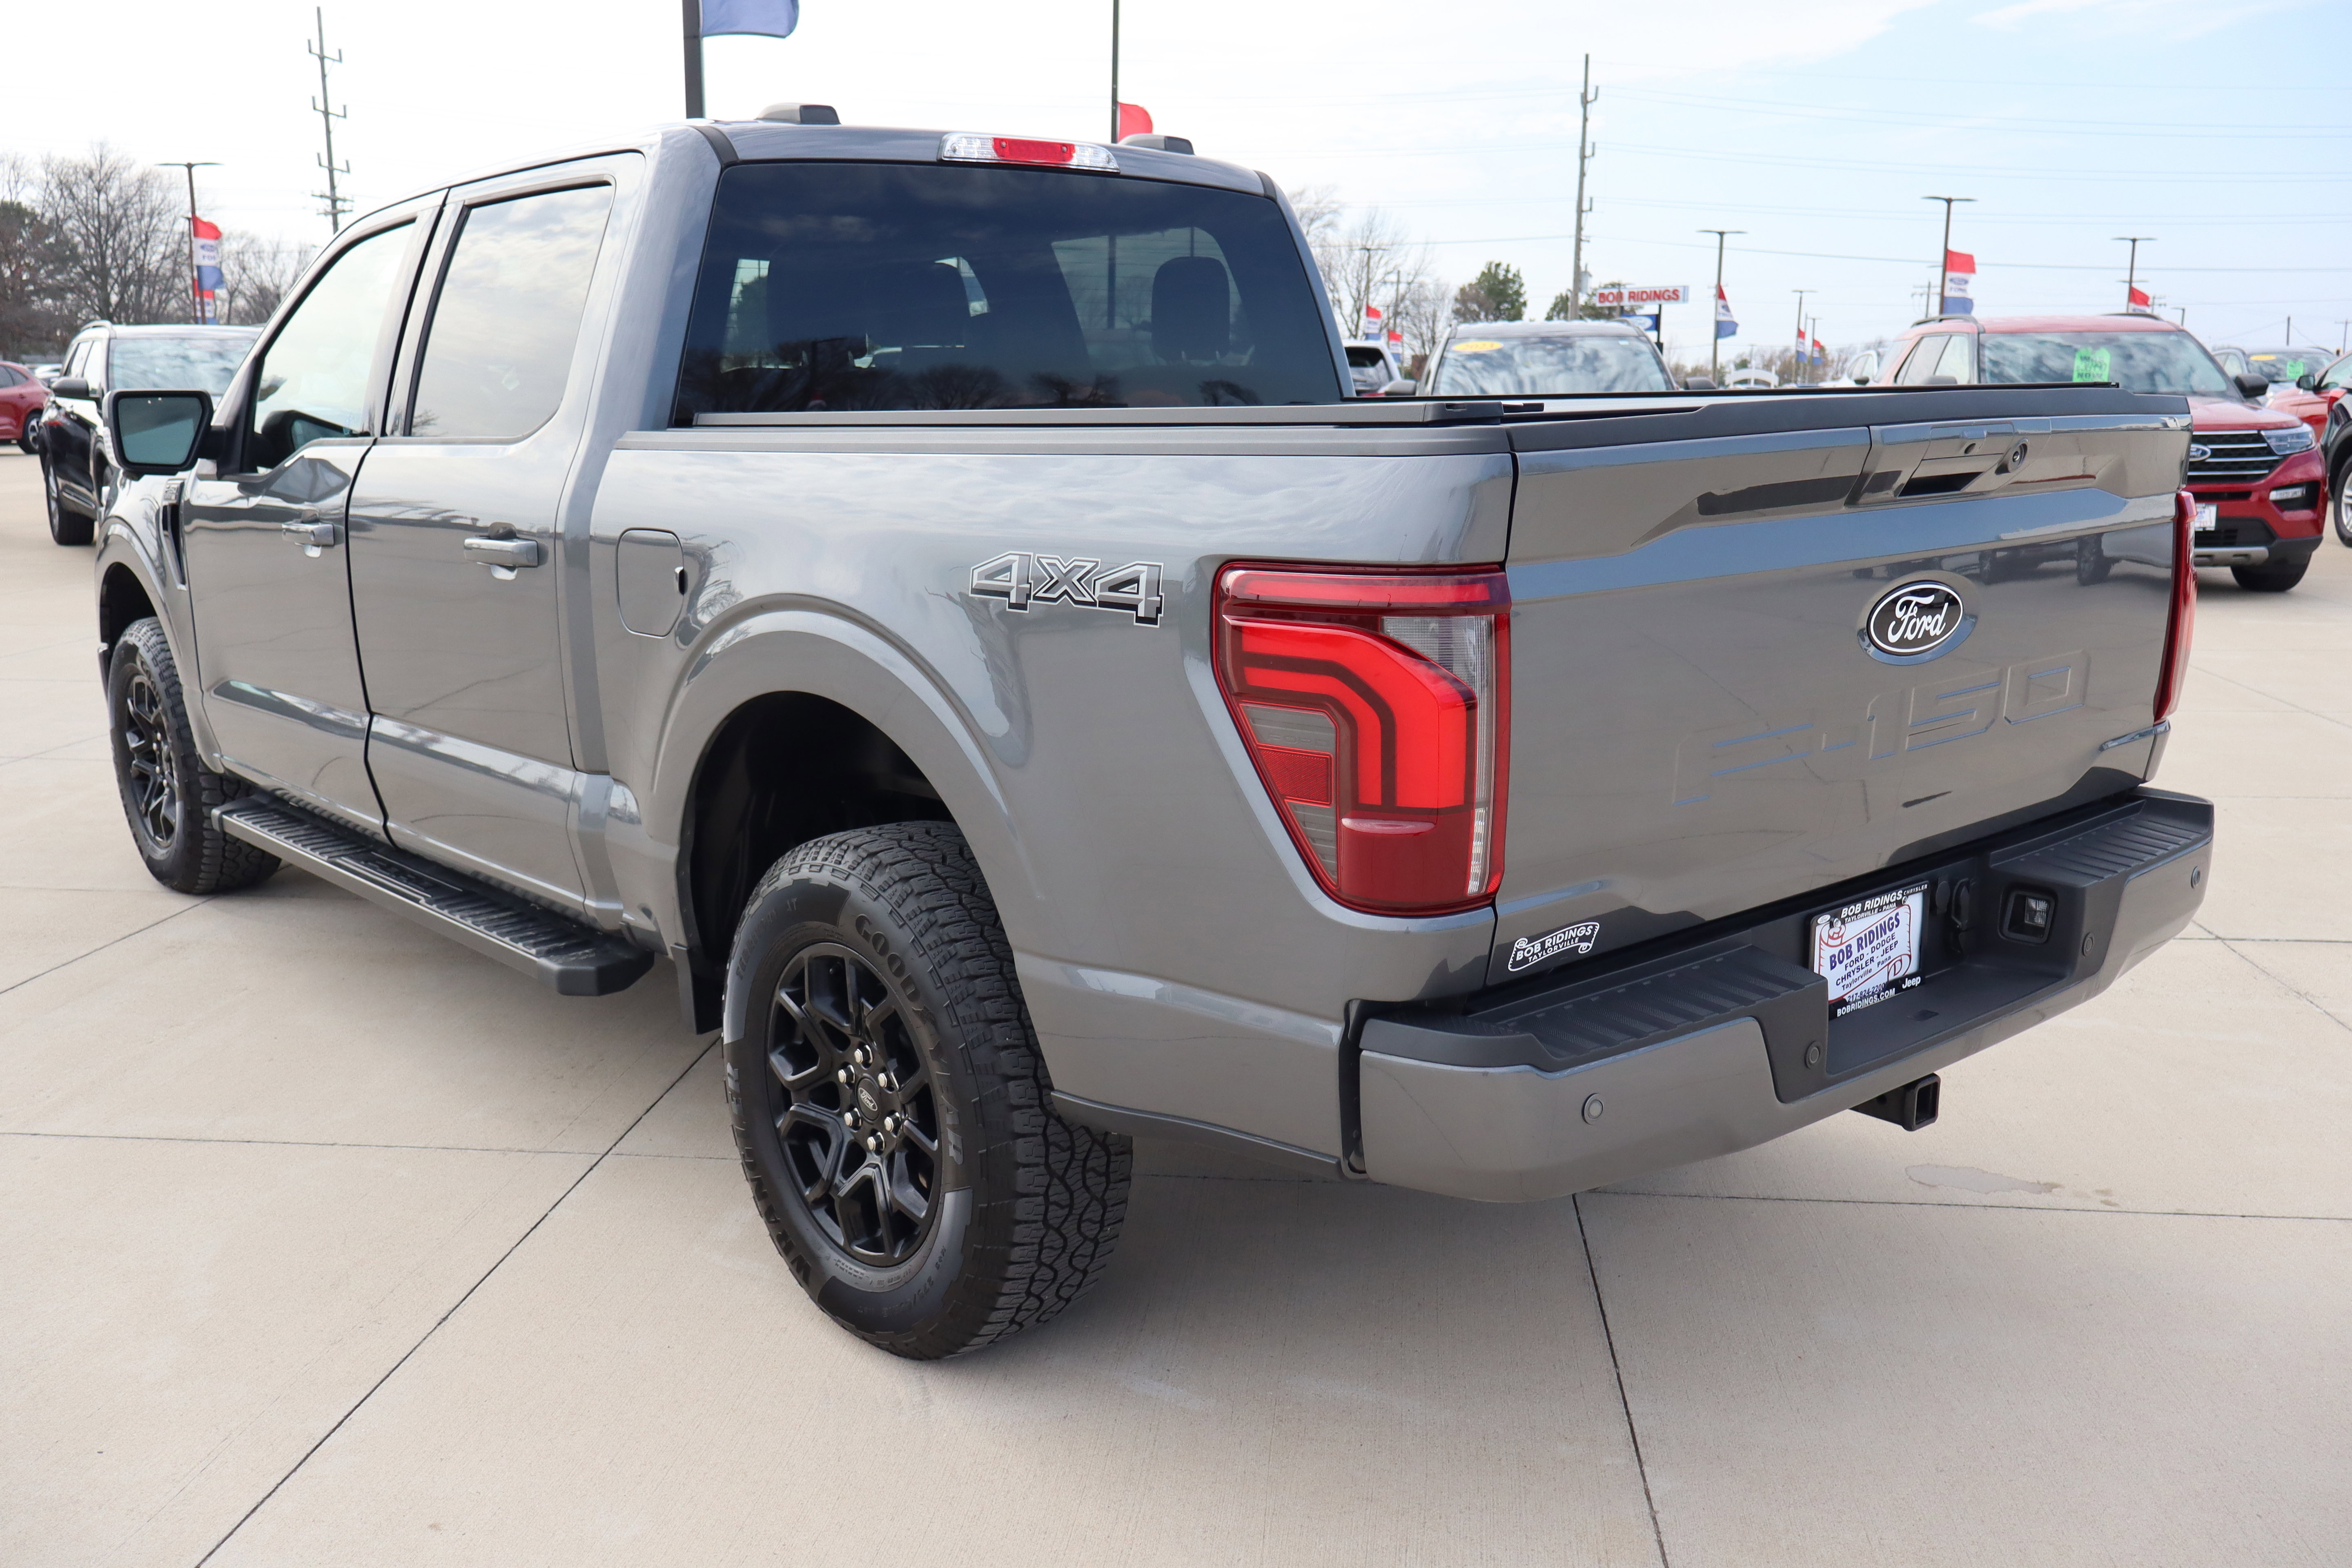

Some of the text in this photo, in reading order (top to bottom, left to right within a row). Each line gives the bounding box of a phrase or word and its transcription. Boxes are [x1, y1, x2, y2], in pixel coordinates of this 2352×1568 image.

[1598, 289, 1679, 303] BOB RIDINGS
[1888, 595, 1949, 643] Ford
[1904, 884, 1928, 895] CHRYSLER
[1841, 890, 1903, 918] BOB RIDINGS
[1844, 908, 1878, 924] TAYLORVILLE
[1882, 902, 1896, 911] PANA
[1516, 925, 1593, 961] BOB RIDINGS
[1528, 937, 1579, 962] TAYLORVILLE
[1829, 912, 1900, 971] BOB RIDINGS
[1845, 953, 1864, 971] FORD
[1871, 932, 1896, 954] DODGE
[1836, 956, 1874, 986] CHRYSLER
[1881, 940, 1898, 957] JEEP
[1842, 956, 1891, 991] Taylorville Pana
[1848, 982, 1885, 1002] 217-824-2200
[1902, 976, 1921, 989] Jeep
[1837, 988, 1895, 1017] BOBRIDINGS.COM
[861, 1091, 874, 1108] Ford
